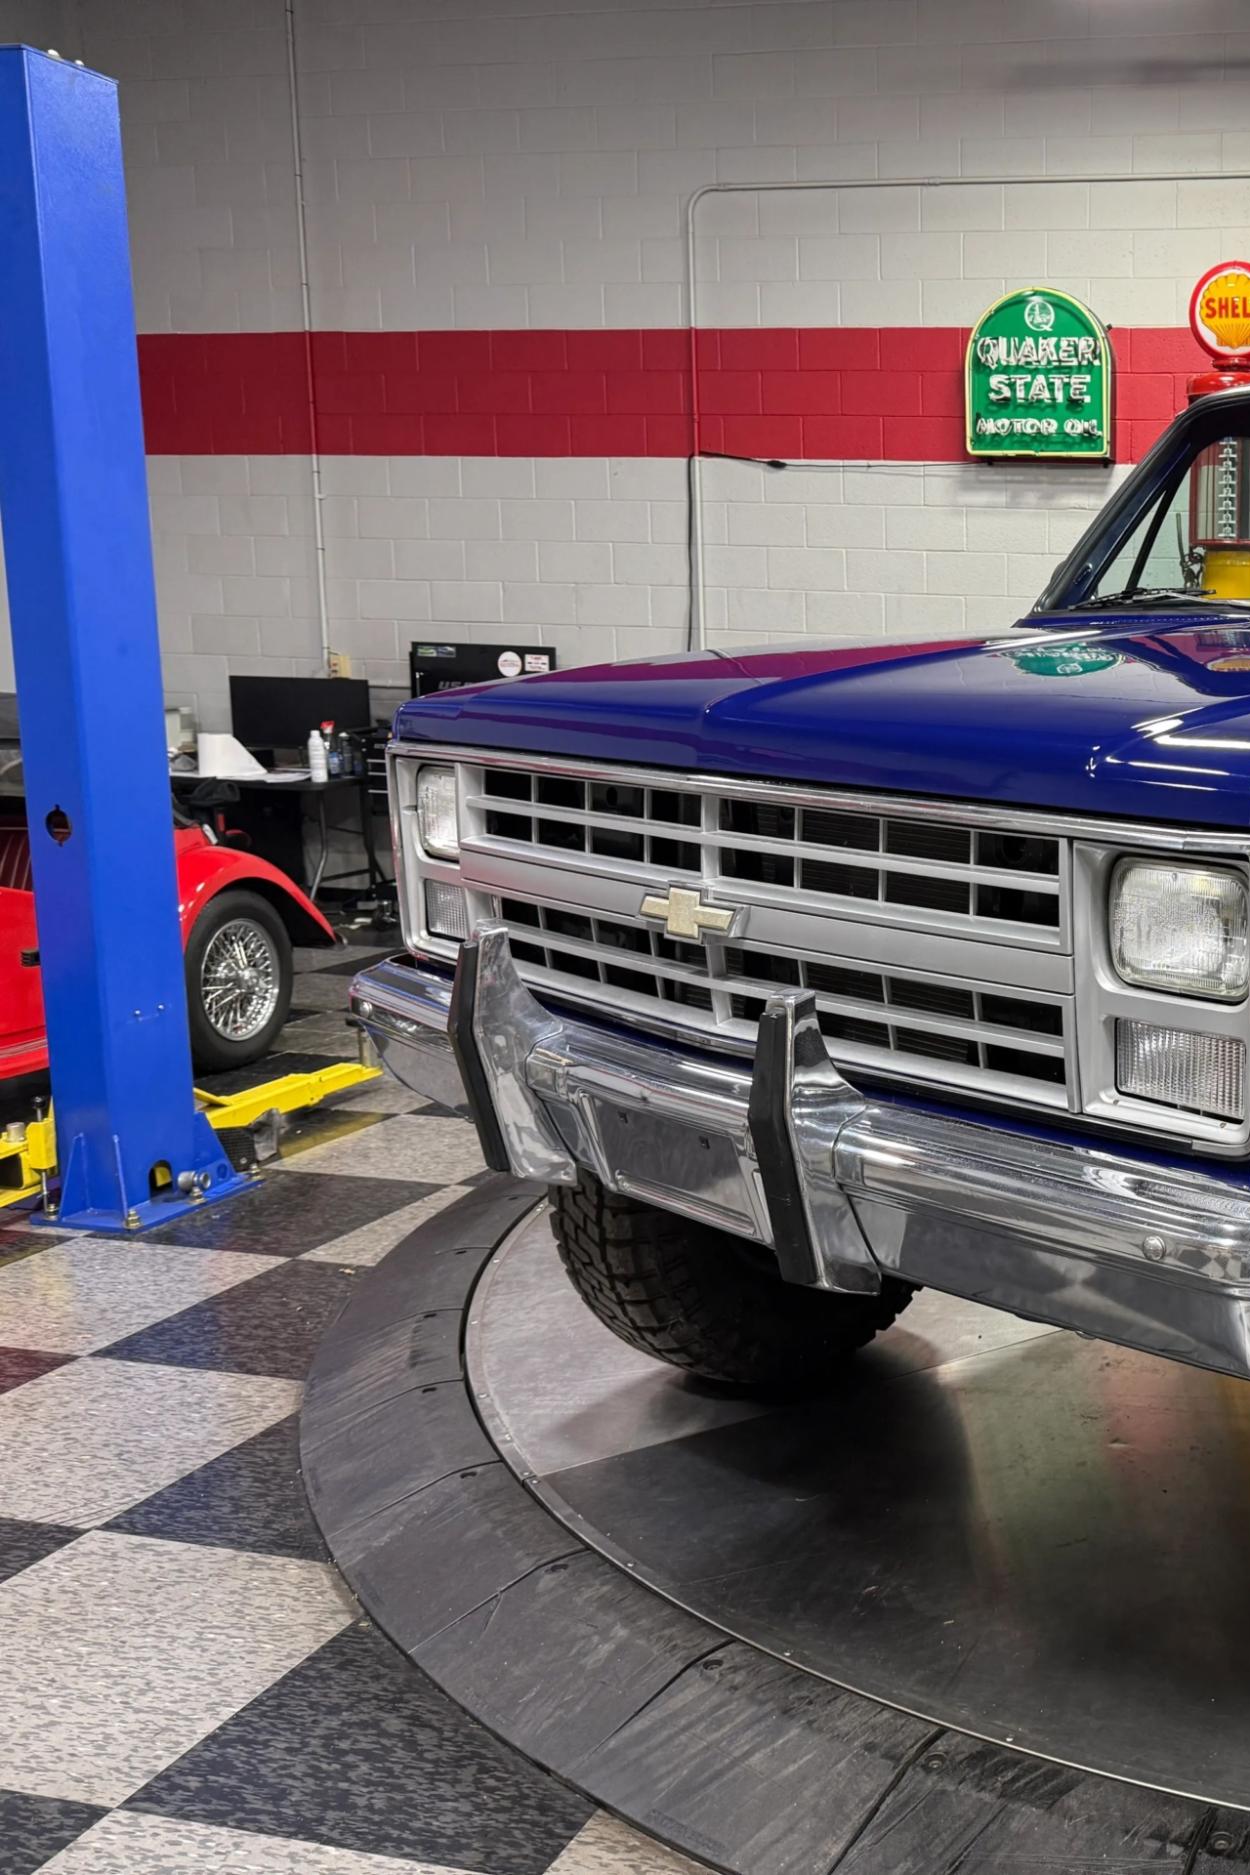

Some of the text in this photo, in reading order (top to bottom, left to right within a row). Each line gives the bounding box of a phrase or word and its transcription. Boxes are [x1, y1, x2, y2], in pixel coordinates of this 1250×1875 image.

[976, 336, 1101, 369] QUAKER
[988, 374, 1091, 403] STATE
[976, 417, 1103, 437] MOTOR OIL
